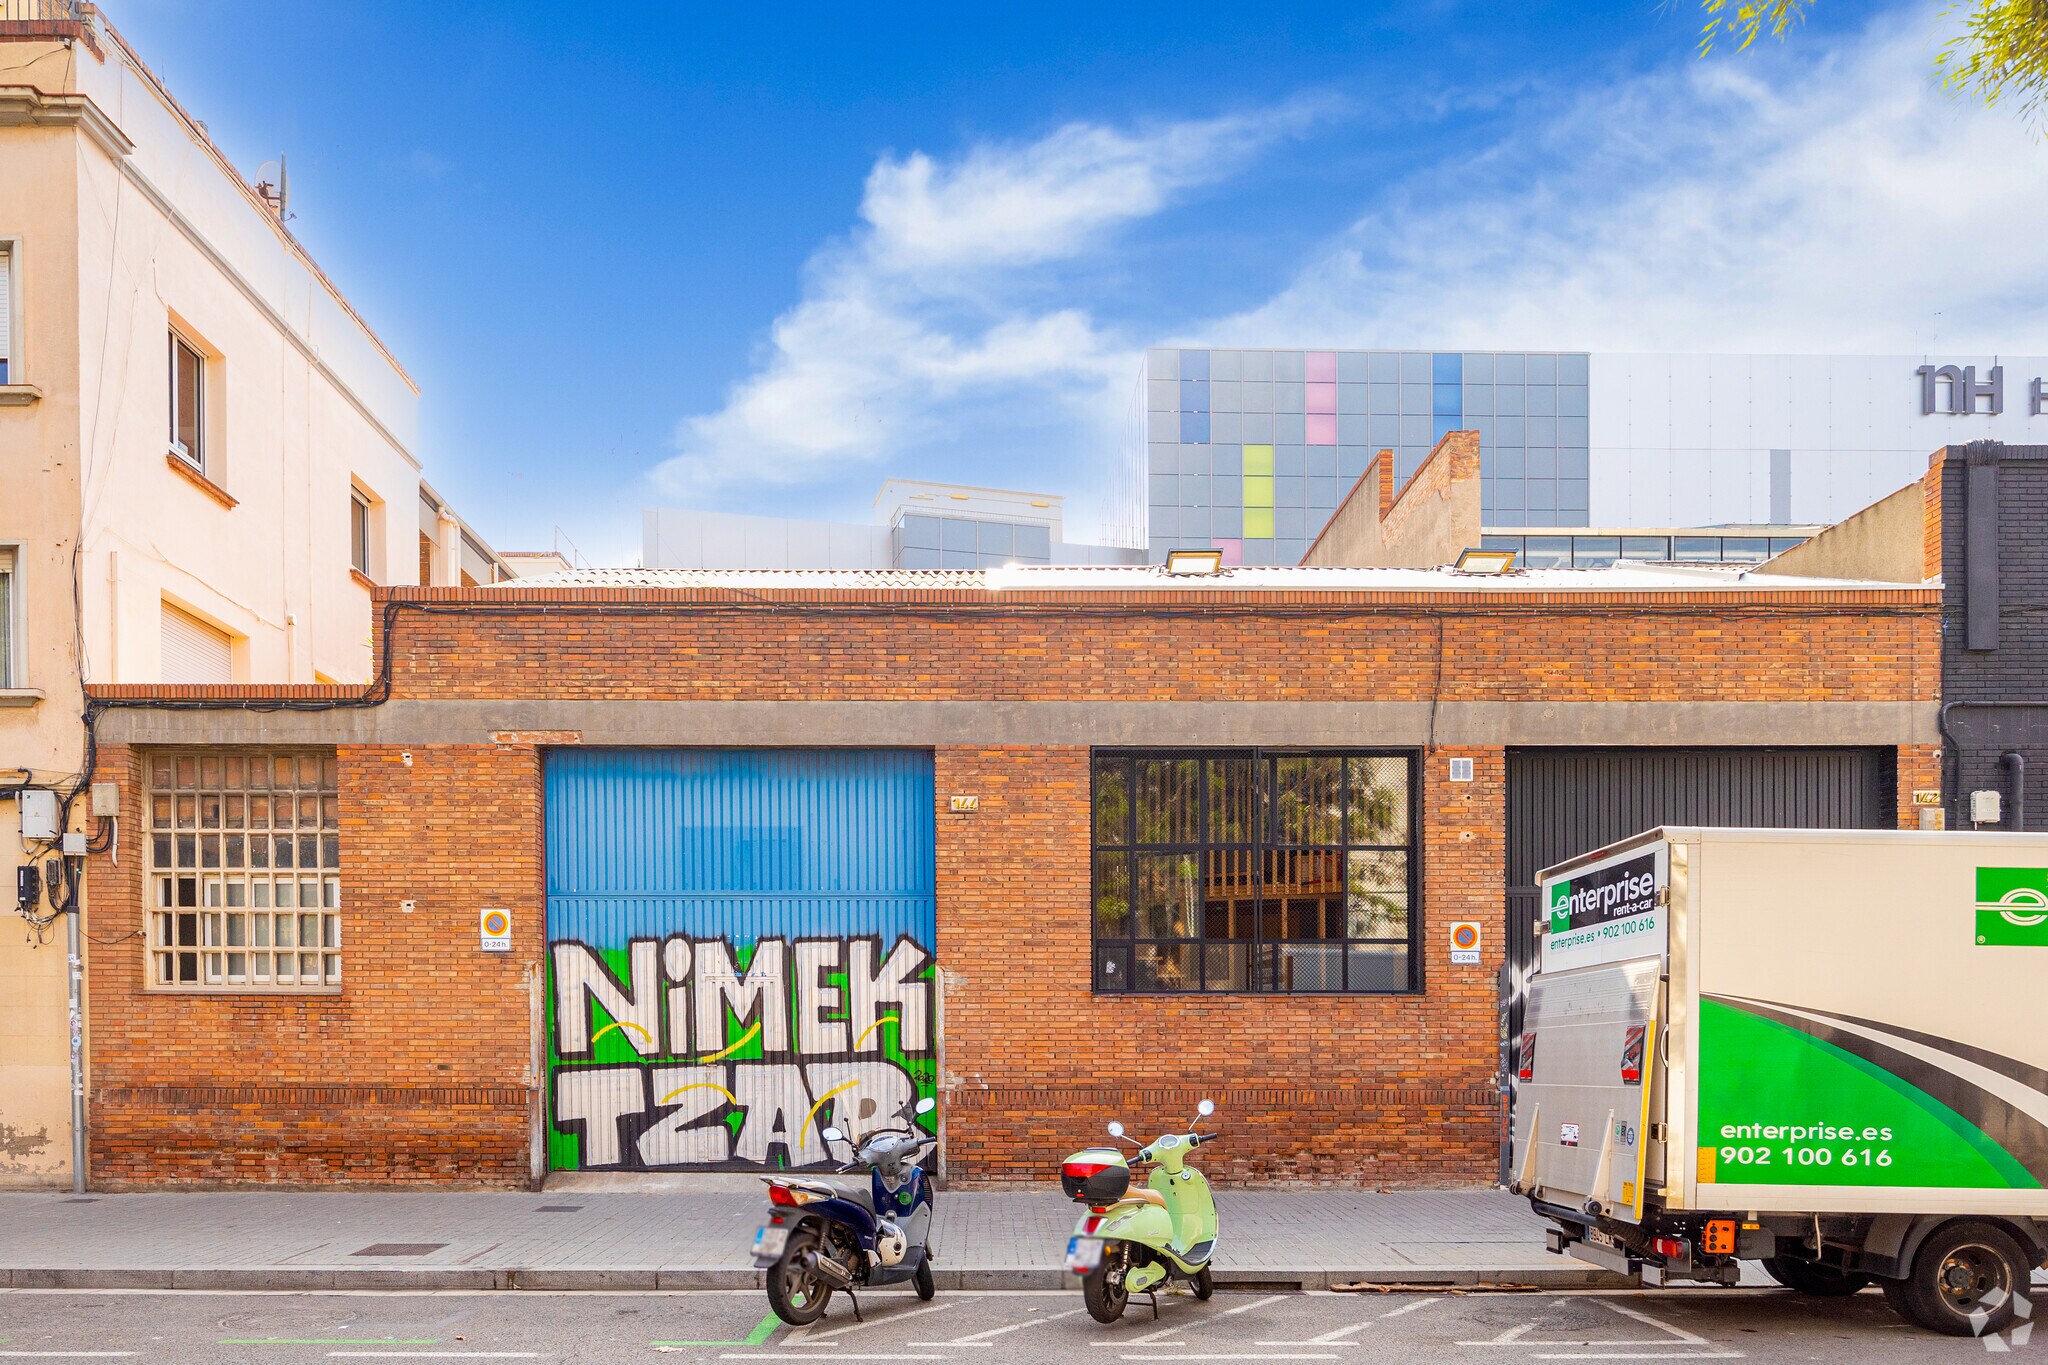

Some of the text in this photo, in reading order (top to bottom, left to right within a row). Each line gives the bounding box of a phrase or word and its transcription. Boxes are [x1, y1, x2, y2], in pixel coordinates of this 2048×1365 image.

[1916, 792, 1940, 804] 142
[1551, 870, 1655, 920] enterprise
[1613, 898, 1653, 917] rent-a-car
[1550, 916, 1655, 950] enterprise.es 902 100 616
[1720, 1121, 1893, 1144] enterprise.es
[1720, 1146, 1771, 1165] 902
[1782, 1147, 1832, 1166] 100
[1841, 1148, 1893, 1167] 616
